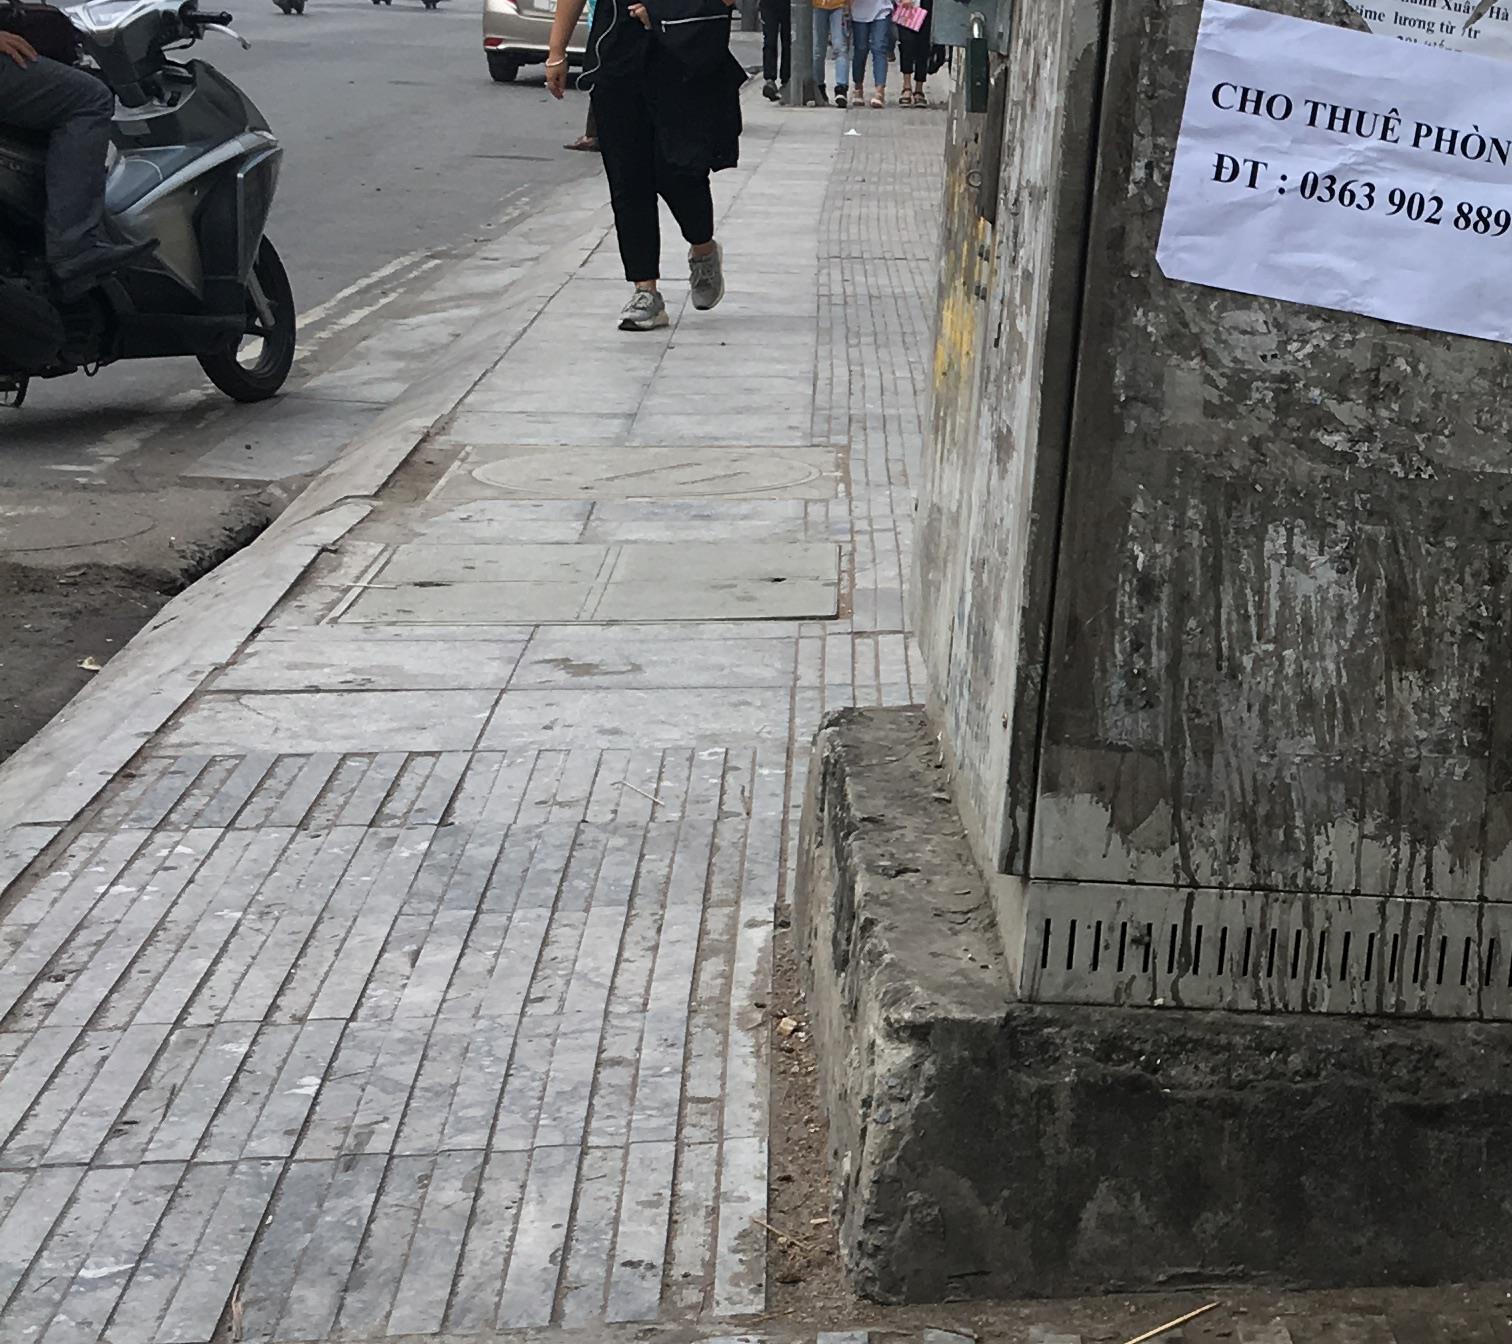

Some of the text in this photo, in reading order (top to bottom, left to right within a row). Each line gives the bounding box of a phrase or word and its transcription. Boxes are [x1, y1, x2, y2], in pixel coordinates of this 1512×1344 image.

[1393, 11, 1435, 34] lương
[1439, 20, 1456, 35] từ
[1488, 5, 1509, 21] Hà
[1211, 82, 1293, 121] CHO
[1304, 99, 1402, 144] THUÊ
[1300, 170, 1376, 211] 0363
[1384, 188, 1444, 225] 902
[1453, 202, 1512, 237] 889
